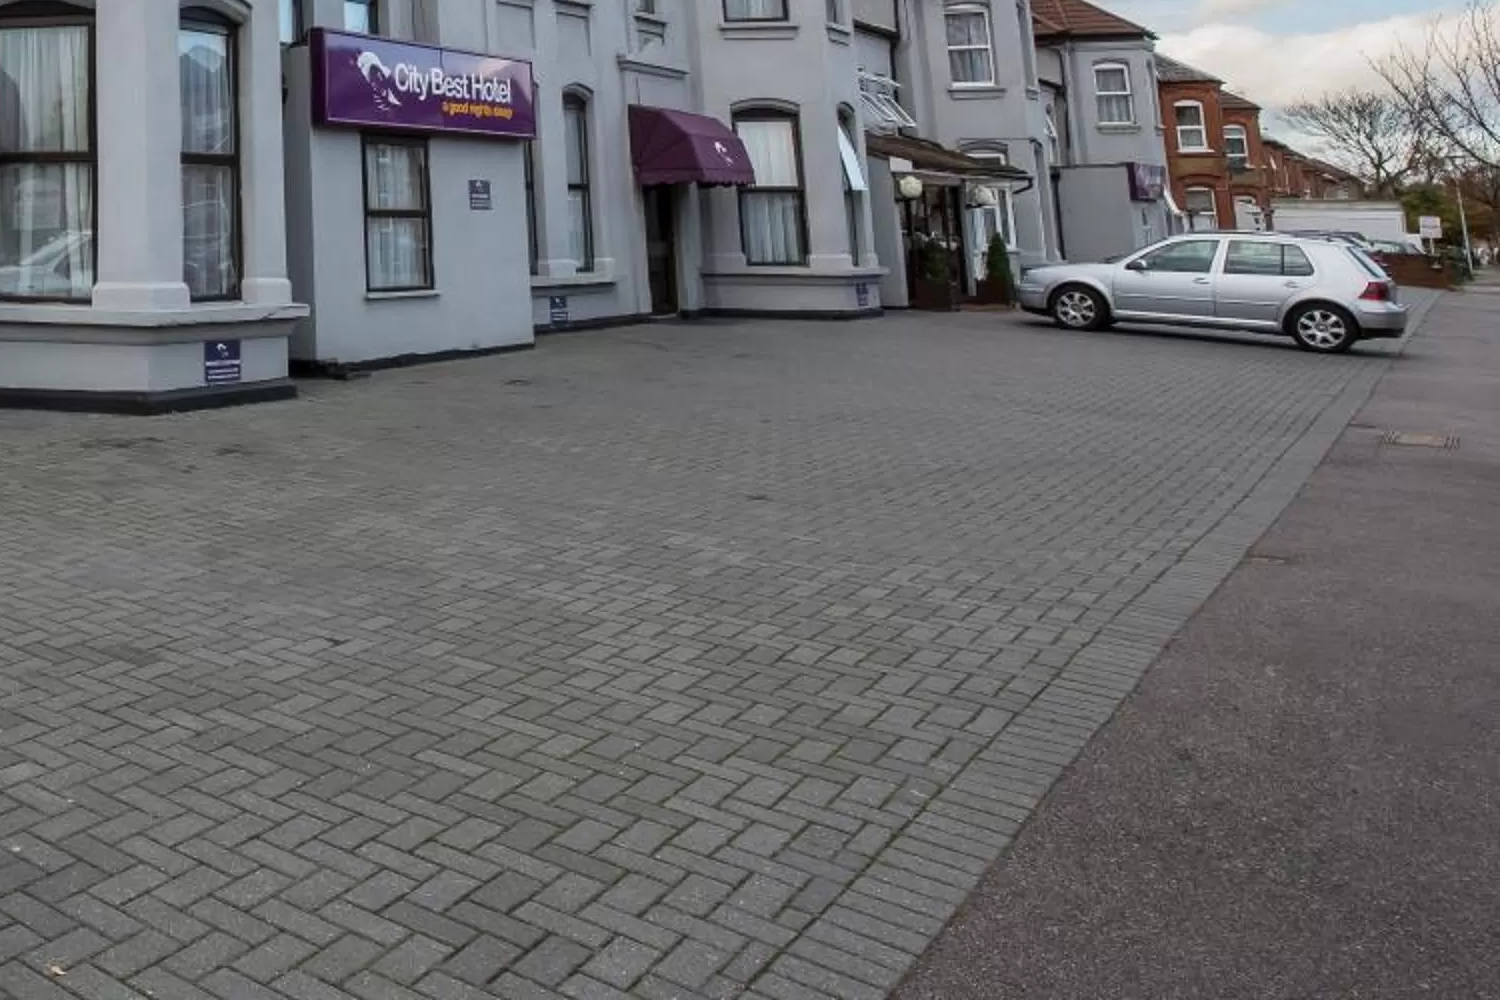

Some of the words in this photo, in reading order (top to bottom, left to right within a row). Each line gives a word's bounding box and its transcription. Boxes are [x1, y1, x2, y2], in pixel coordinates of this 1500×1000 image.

[395, 63, 429, 101] City
[431, 67, 470, 99] Best
[471, 72, 511, 104] Hotel
[449, 102, 468, 117] good
